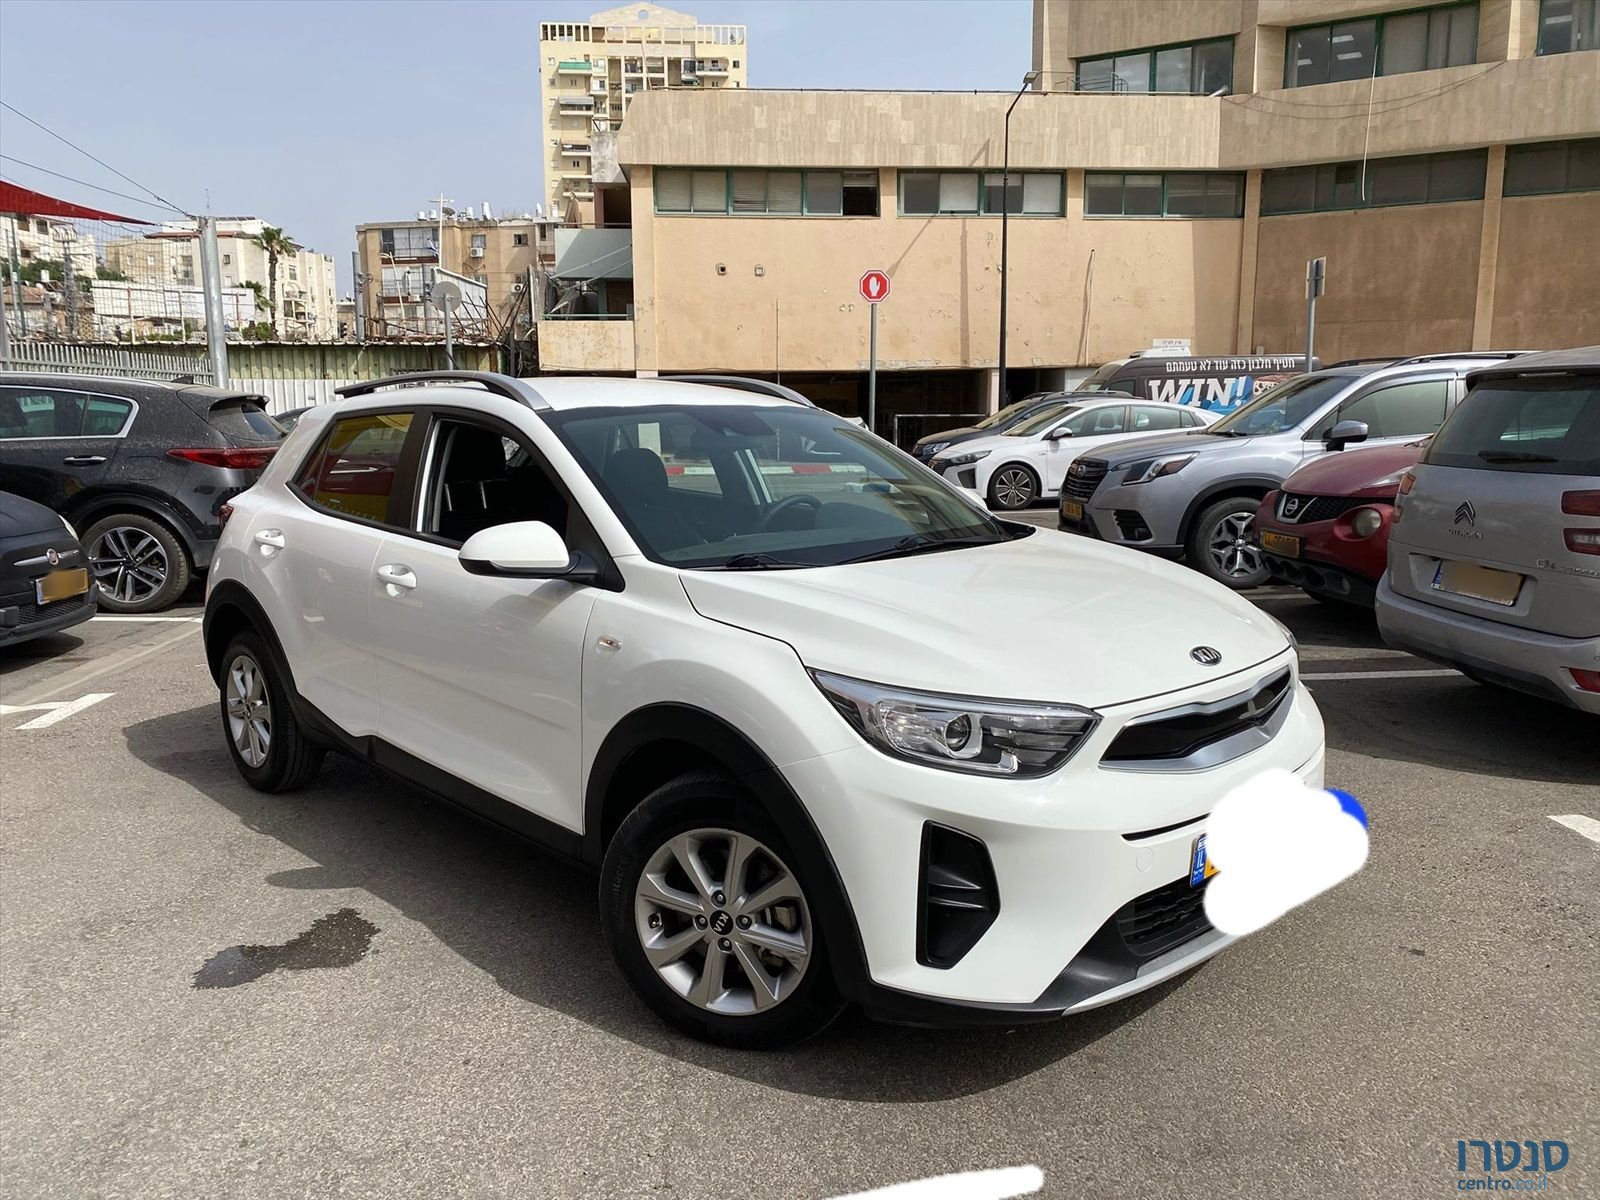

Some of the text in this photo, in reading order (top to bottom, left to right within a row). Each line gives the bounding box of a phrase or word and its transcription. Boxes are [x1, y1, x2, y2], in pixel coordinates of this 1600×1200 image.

[1166, 357, 1295, 372] חטיף חלבון כזה עוד לא טעמתם
[1148, 375, 1247, 407] WIN!
[713, 912, 729, 932] KIA
